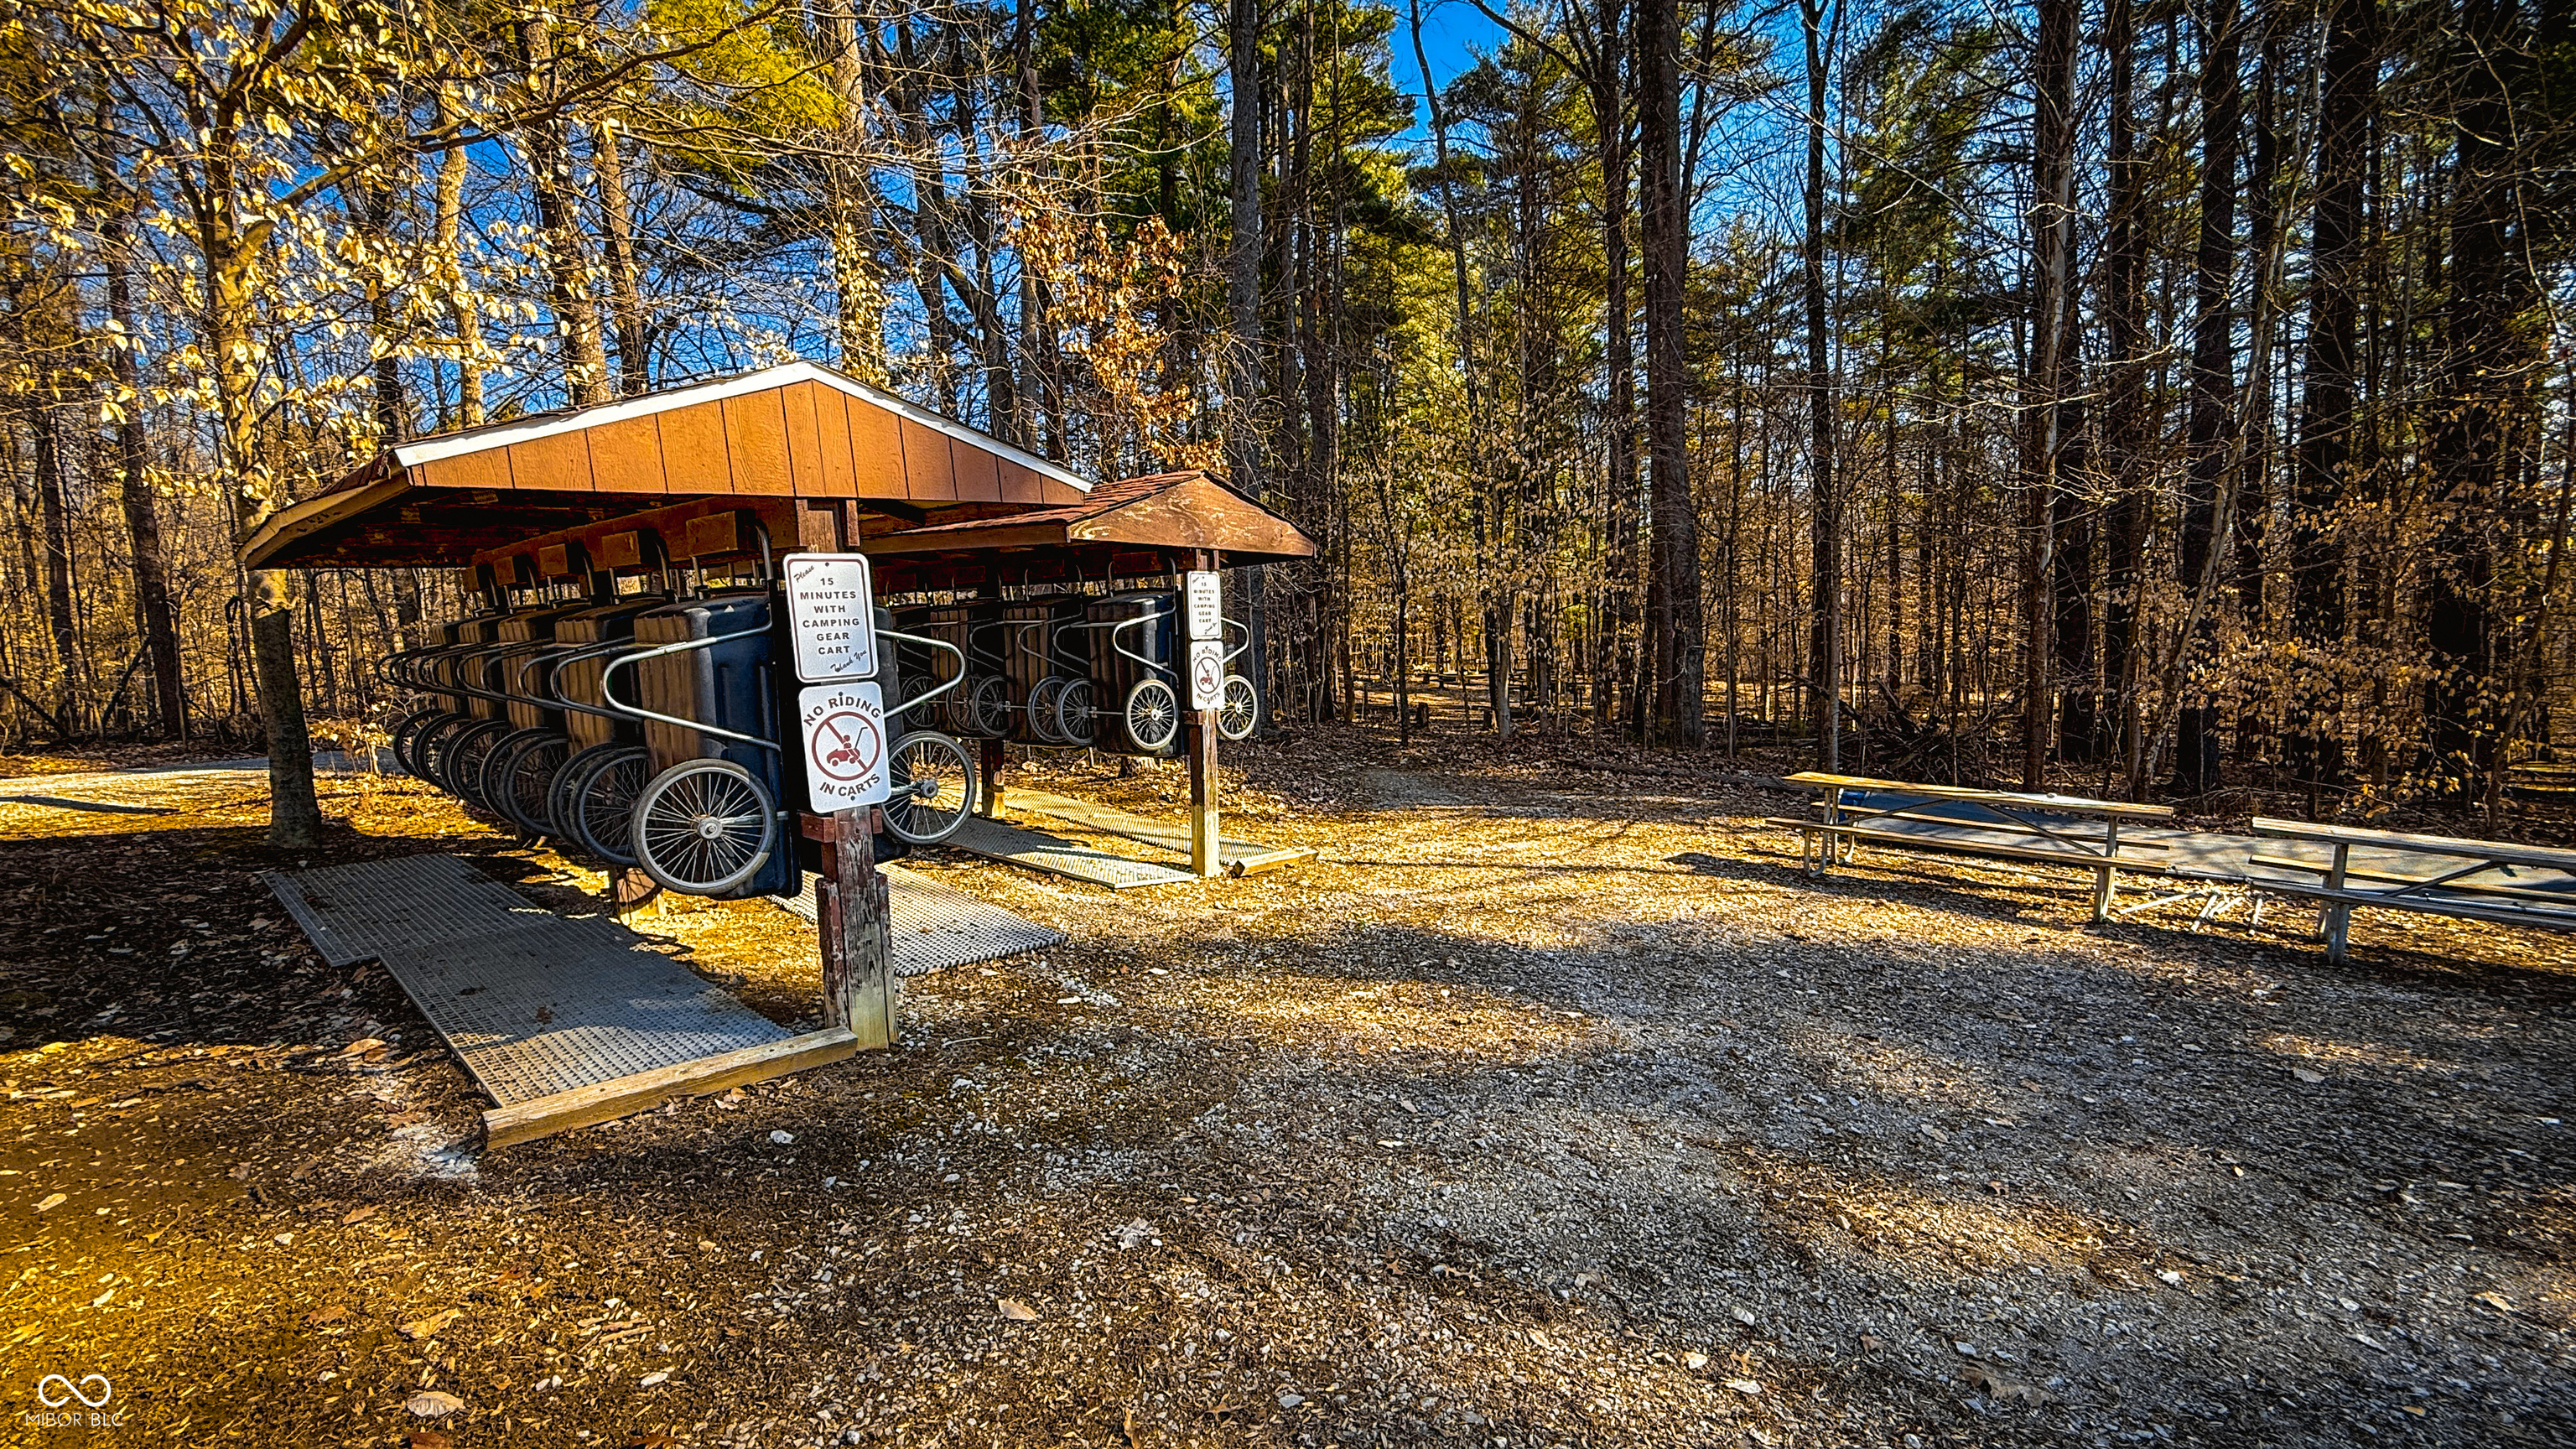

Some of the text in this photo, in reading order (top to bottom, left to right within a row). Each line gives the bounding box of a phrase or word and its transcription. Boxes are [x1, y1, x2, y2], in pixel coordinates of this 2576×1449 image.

[793, 565, 814, 583] Please
[800, 591, 856, 600] MINUTES
[802, 618, 860, 628] CAMPING
[816, 632, 849, 641] GEAR
[818, 646, 850, 655] CART
[1192, 648, 1222, 662] NO RIDING
[830, 649, 867, 672] Thank You
[1203, 692, 1220, 703] CARTS
[803, 696, 881, 727] NO RIDING
[819, 773, 880, 797] IN CARTS
